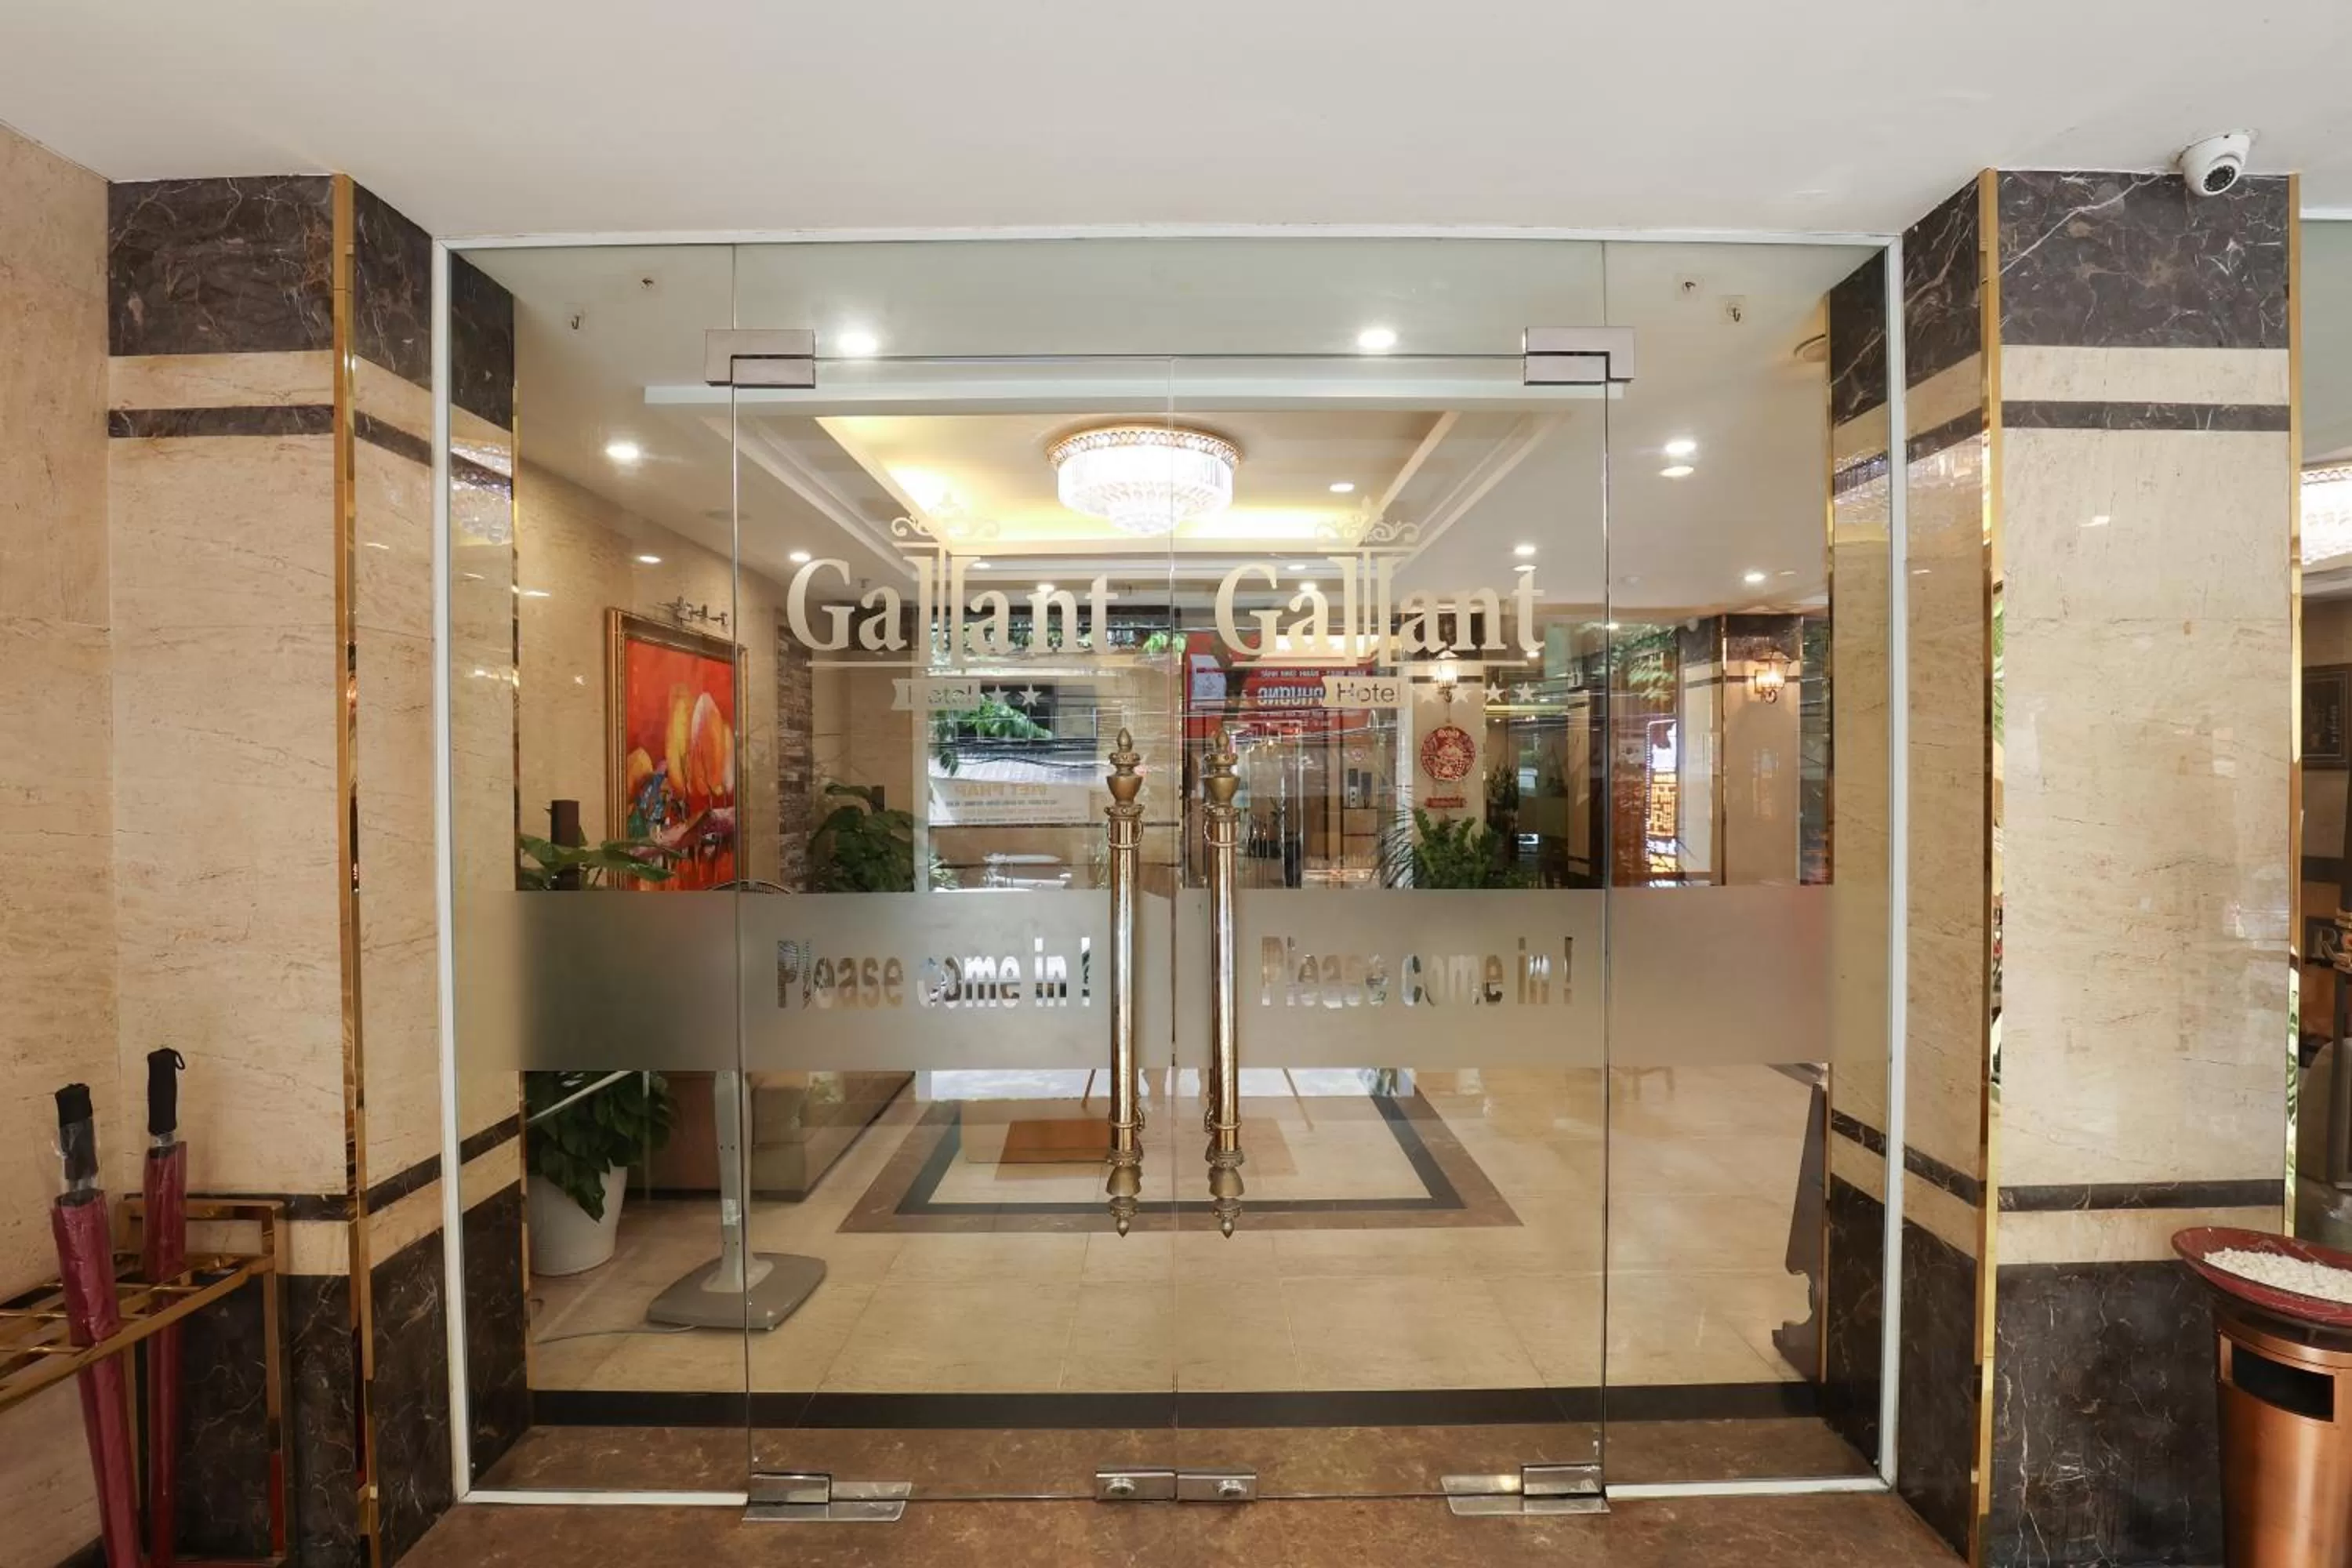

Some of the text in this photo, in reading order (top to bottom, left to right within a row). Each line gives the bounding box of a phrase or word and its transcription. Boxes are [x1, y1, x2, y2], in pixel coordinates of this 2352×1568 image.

[786, 555, 1120, 667] Gallant
[1214, 555, 1545, 667] Gallant
[1337, 682, 1402, 703] Hotel
[777, 940, 904, 1009] Please
[1033, 937, 1067, 1007] in
[1261, 935, 1388, 1008] Please
[1517, 937, 1551, 1004] in
